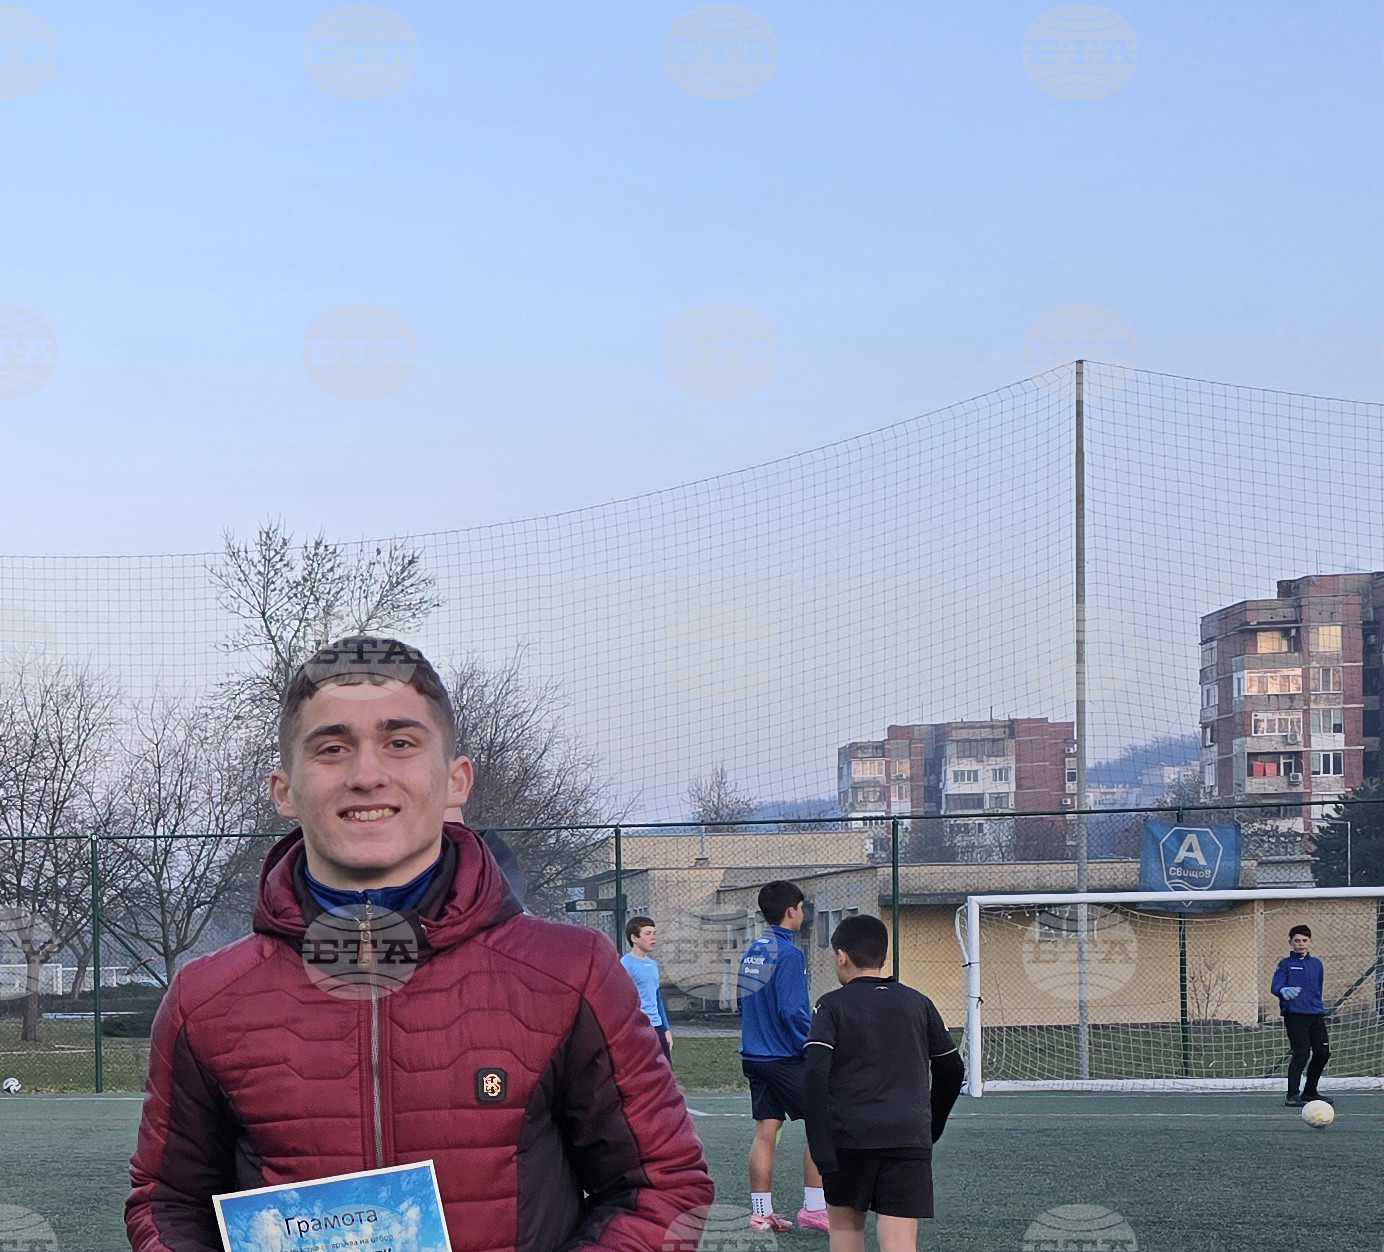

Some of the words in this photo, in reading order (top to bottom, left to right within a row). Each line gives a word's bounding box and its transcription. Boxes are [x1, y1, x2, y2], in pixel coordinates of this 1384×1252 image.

[1169, 866, 1212, 879] Свищов
[284, 1209, 378, 1238] Грамота
[370, 1234, 394, 1245] отбор
